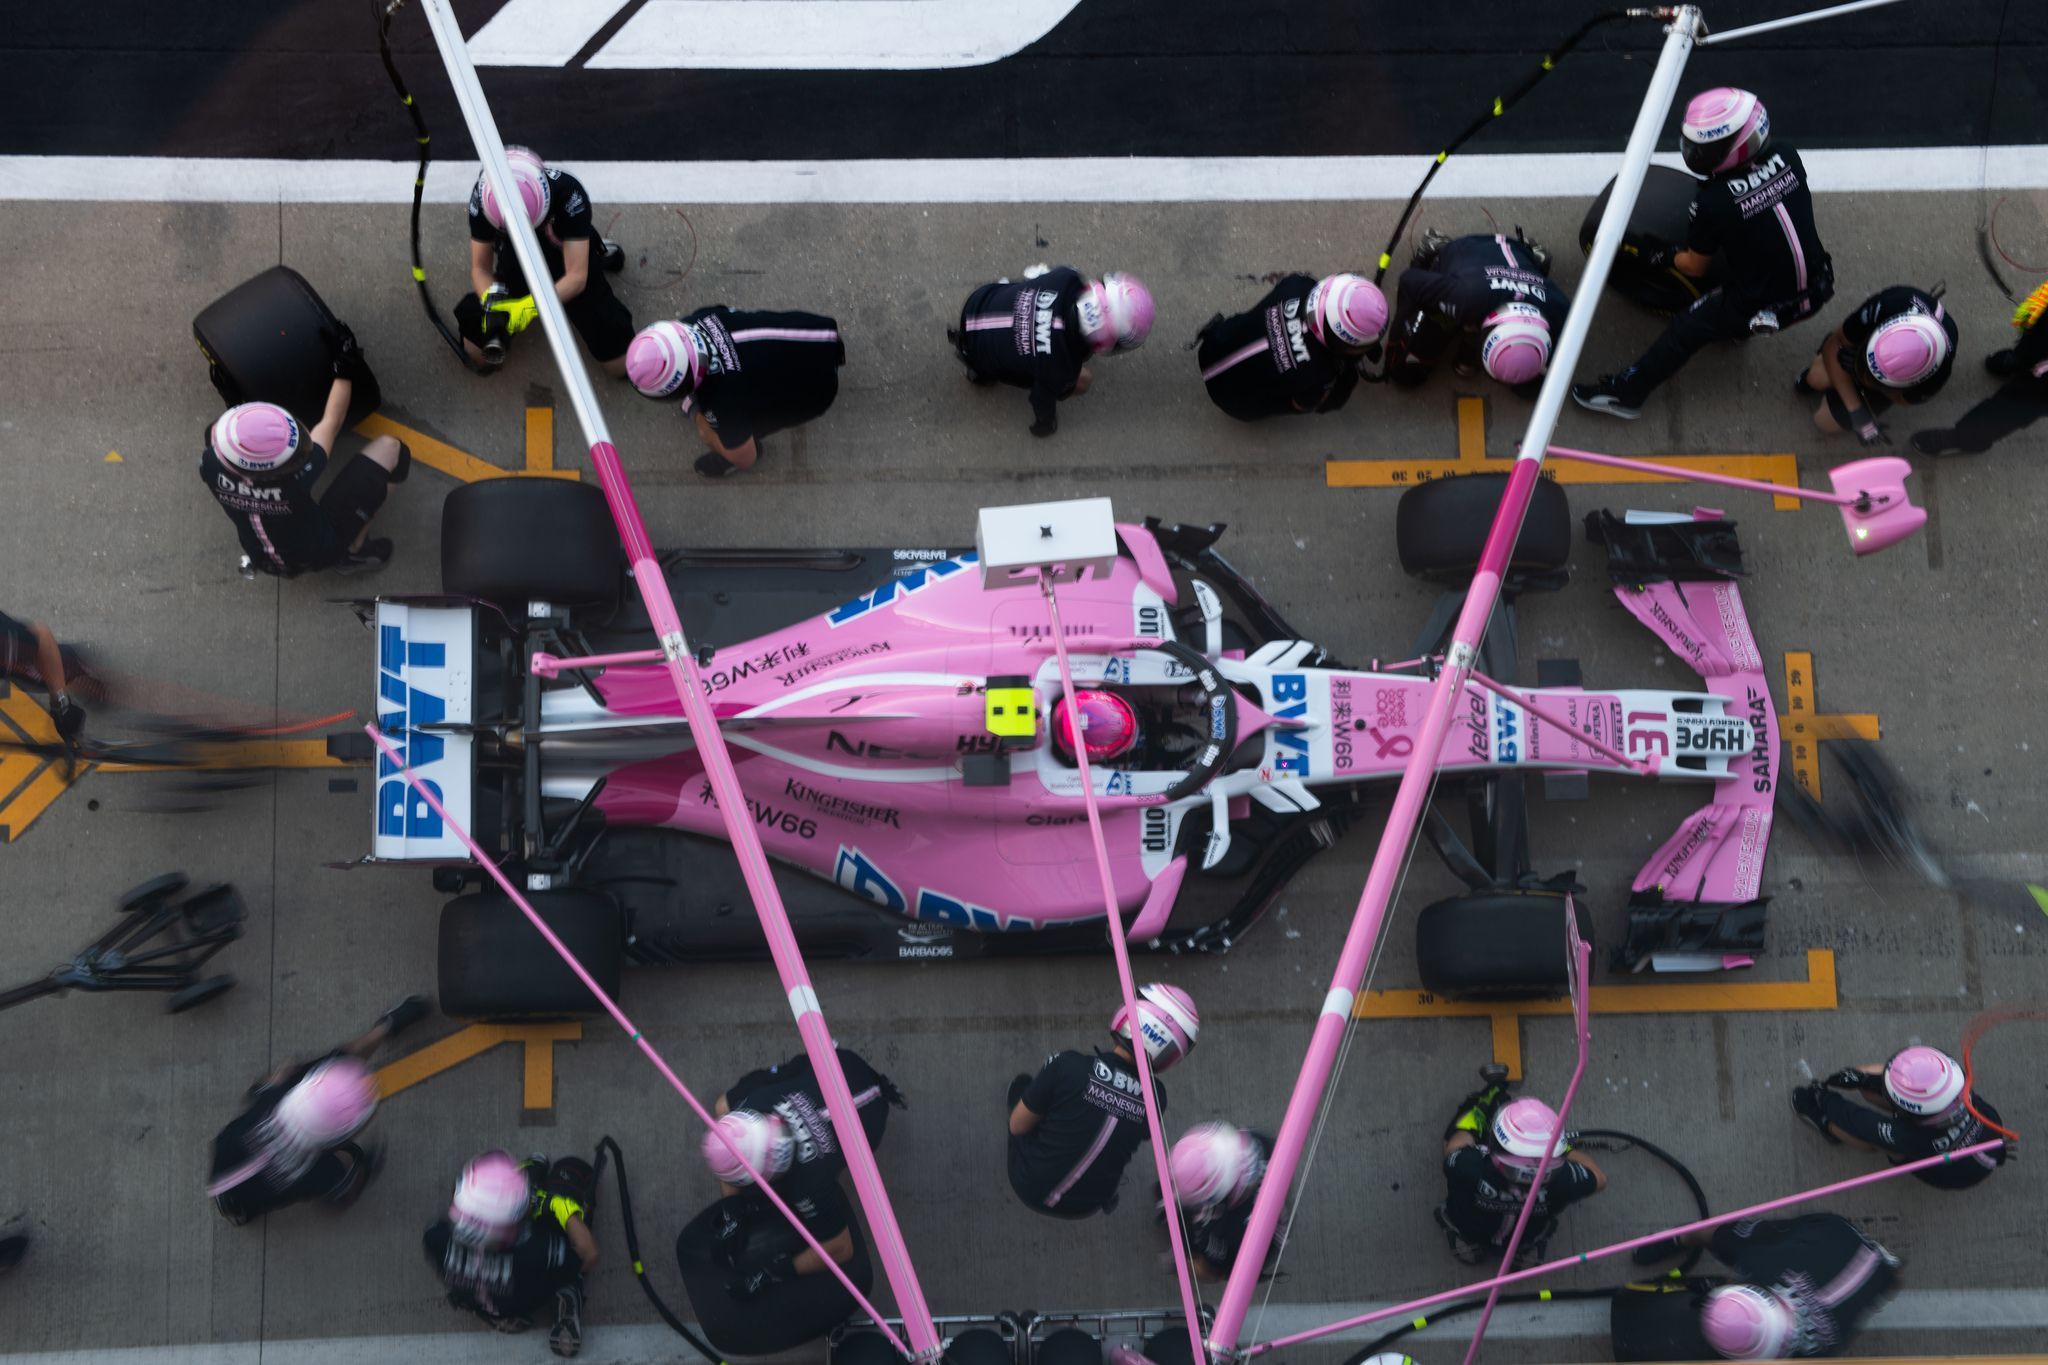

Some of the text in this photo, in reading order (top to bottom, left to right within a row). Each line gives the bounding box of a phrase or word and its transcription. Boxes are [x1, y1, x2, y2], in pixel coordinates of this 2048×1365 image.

[1740, 171, 1797, 212] MAGNESIUM
[1747, 153, 1786, 190] BWT
[1490, 278, 1530, 295] BWT
[1036, 309, 1053, 354] BWT
[1271, 307, 1292, 371] MAGNESIUM
[1286, 318, 1311, 362] BWT
[238, 482, 282, 501] BWT
[893, 550, 946, 560] BARBADOS
[378, 624, 446, 839] BWT
[1272, 674, 1310, 777] BWT
[1465, 688, 1489, 762] telcel
[1627, 711, 1670, 757] 31
[1676, 727, 1745, 751] HYPE
[1748, 696, 1772, 794] SAHARA
[785, 777, 901, 830] KINGFISHER
[899, 946, 953, 957] BARBADOS
[1142, 1023, 1168, 1047] BWT
[1087, 1085, 1146, 1117] MAGNESIUM
[1112, 1071, 1144, 1096] BW
